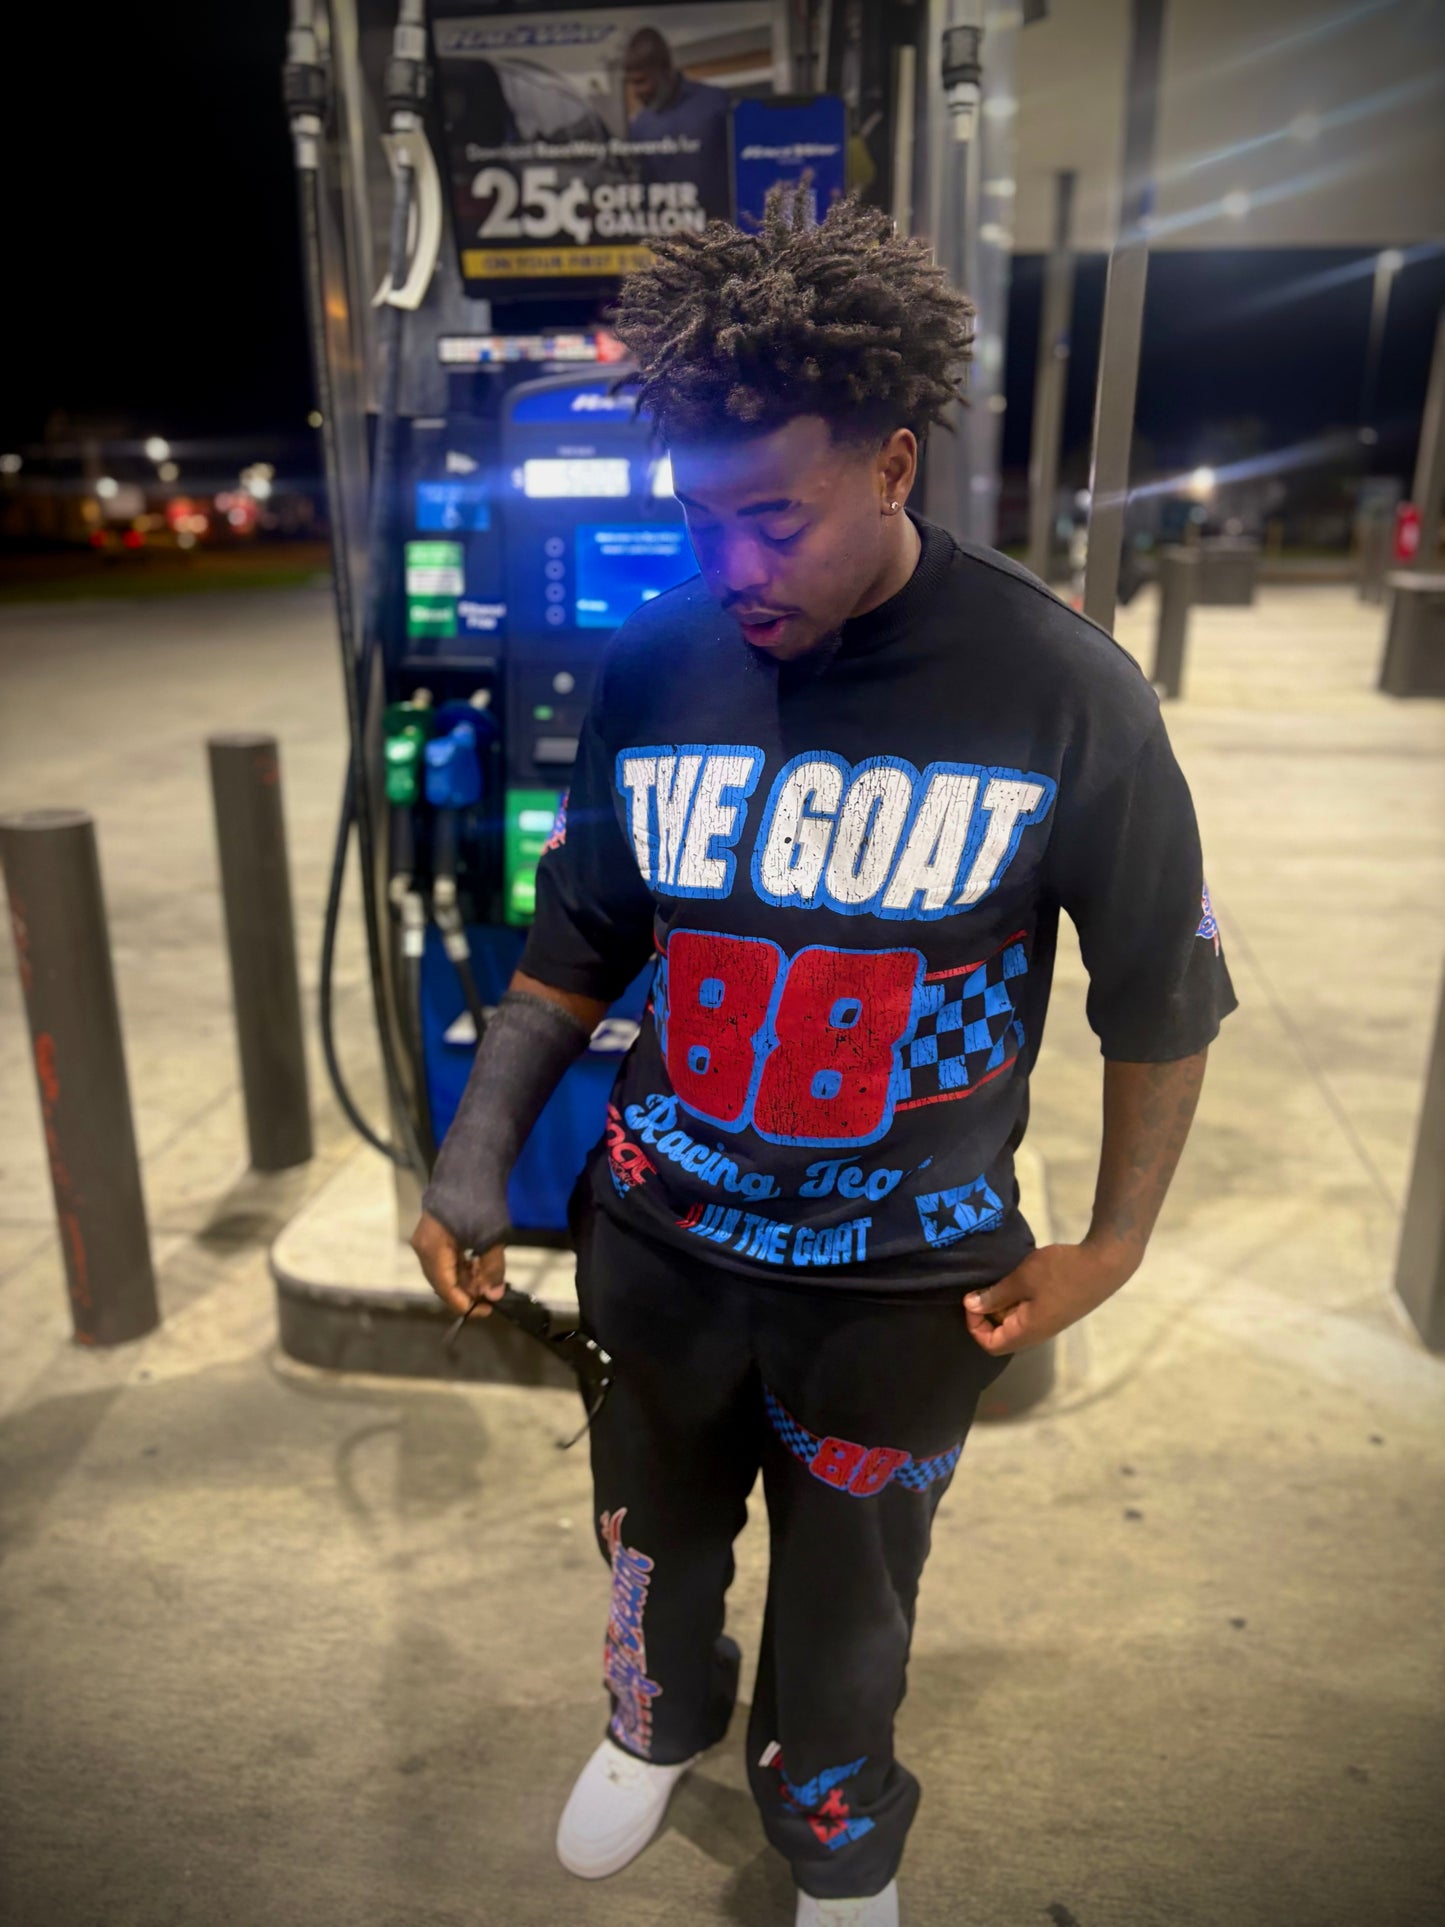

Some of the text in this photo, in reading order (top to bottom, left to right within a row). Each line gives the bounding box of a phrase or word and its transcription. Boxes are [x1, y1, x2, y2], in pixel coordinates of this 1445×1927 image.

[471, 166, 592, 244] 25¢
[593, 181, 699, 209] OFF PER
[595, 208, 706, 238] GALLON
[616, 745, 765, 899] THE
[751, 750, 1056, 921] GOAT
[665, 928, 927, 1148] 88
[624, 1093, 781, 1202] Racing
[733, 1212, 793, 1266] THE
[792, 1216, 873, 1267] GOAT
[808, 1436, 913, 1498] 88
